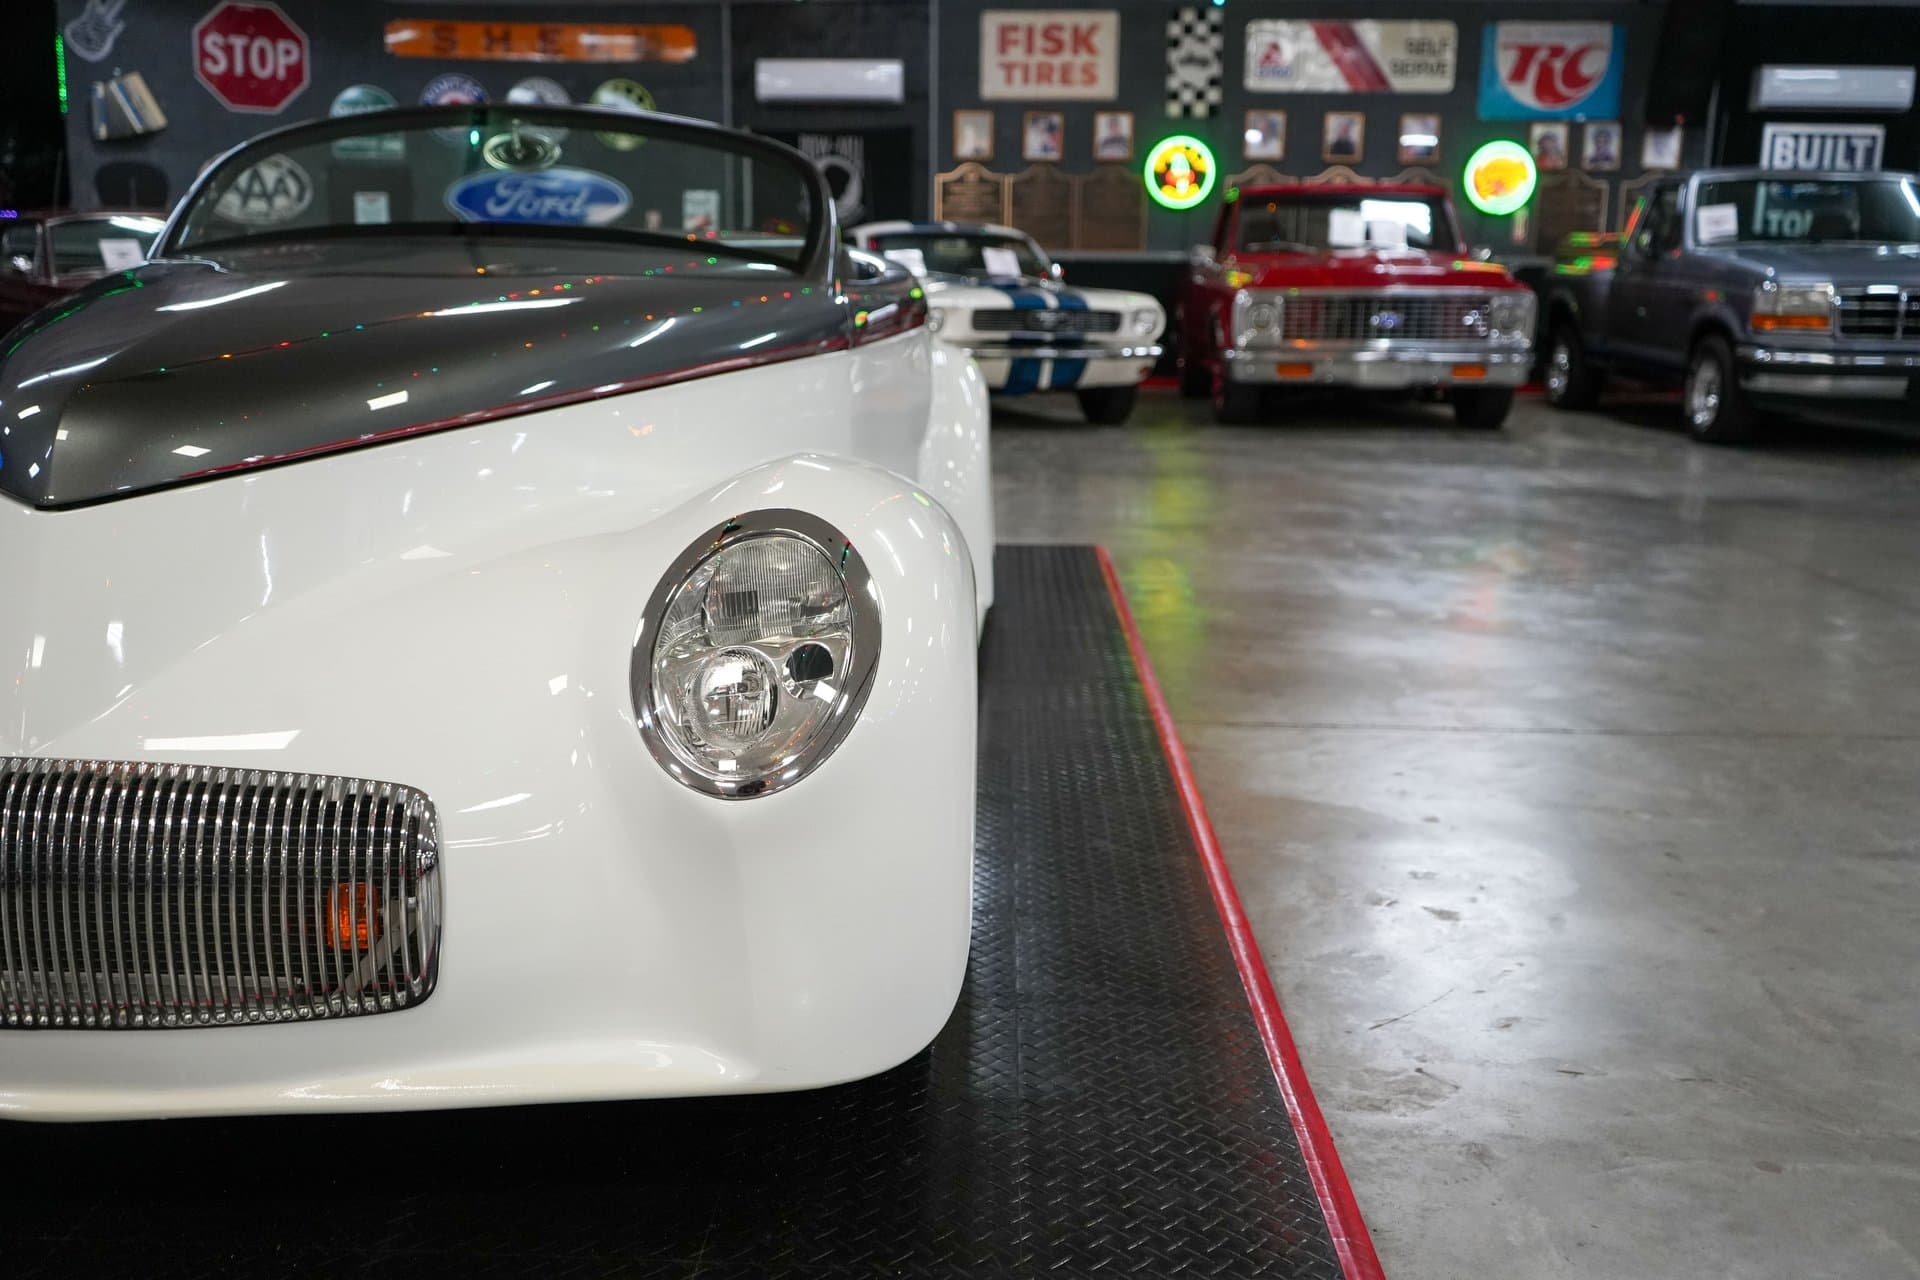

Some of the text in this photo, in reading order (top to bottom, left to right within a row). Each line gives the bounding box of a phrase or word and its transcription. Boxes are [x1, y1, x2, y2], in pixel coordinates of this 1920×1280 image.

[202, 31, 300, 80] STOP
[997, 23, 1101, 55] FISK
[1405, 37, 1449, 56] SELF
[998, 60, 1099, 86] TIRES
[1391, 60, 1449, 77] SERVE
[1502, 42, 1607, 105] RC
[1771, 134, 1874, 170] BUILT
[485, 176, 592, 217] Ford
